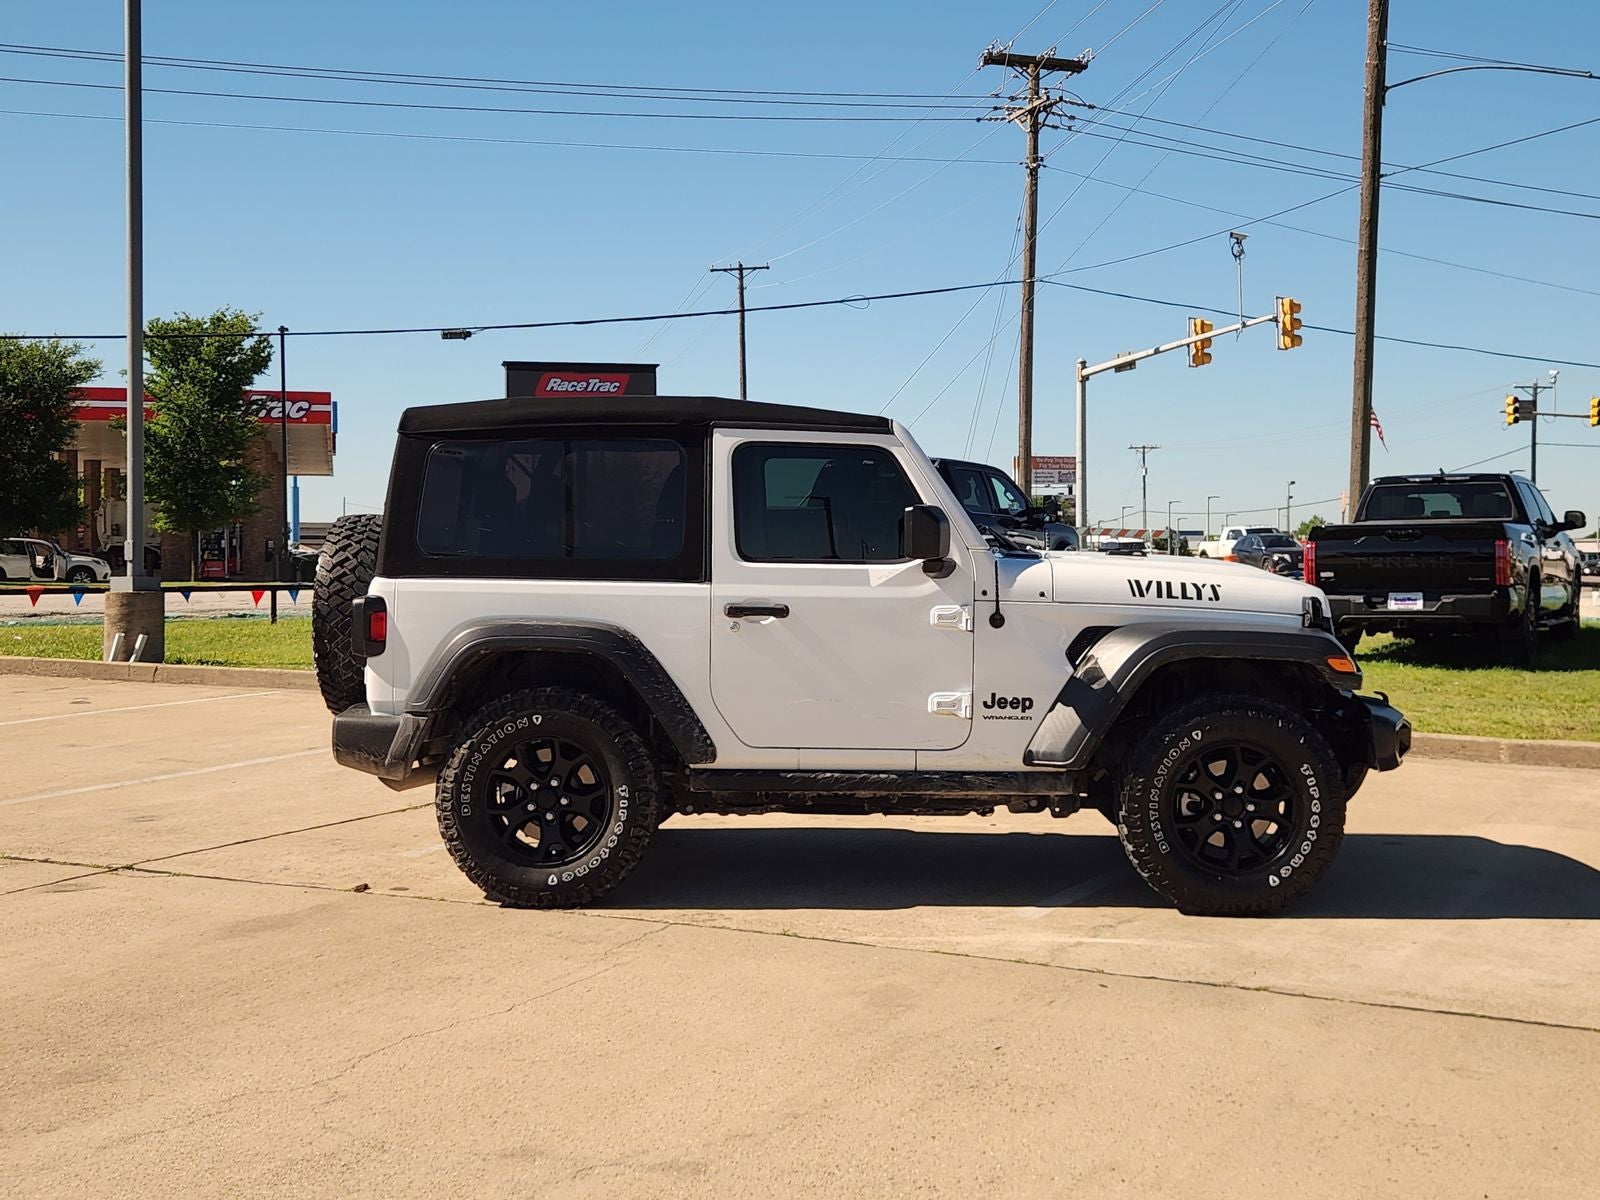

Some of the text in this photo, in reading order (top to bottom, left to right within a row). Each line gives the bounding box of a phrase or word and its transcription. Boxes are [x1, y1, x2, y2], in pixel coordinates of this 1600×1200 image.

[546, 378, 621, 393] RaceTrac
[1127, 579, 1221, 601] WILLYS
[982, 692, 1034, 713] Jeep
[460, 716, 529, 817] DESTINATION
[1149, 737, 1191, 855] DESTINATION
